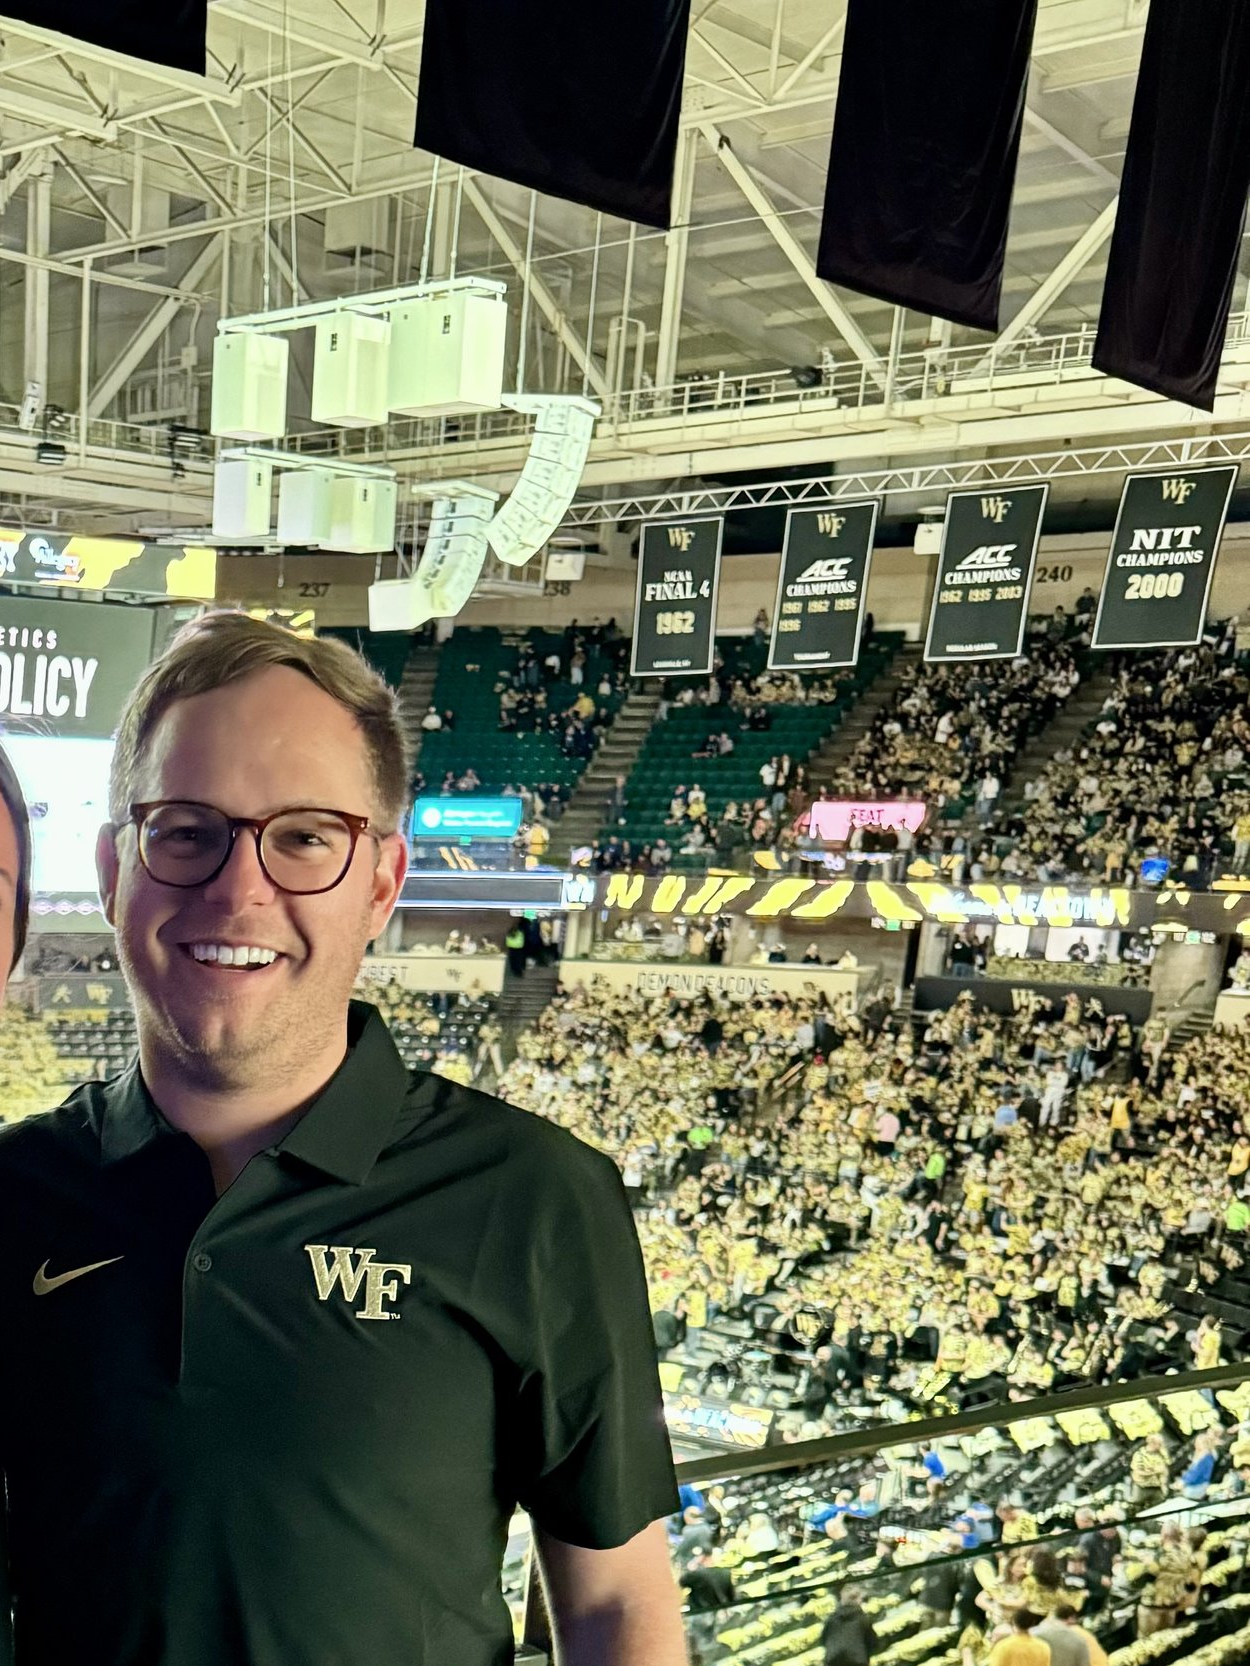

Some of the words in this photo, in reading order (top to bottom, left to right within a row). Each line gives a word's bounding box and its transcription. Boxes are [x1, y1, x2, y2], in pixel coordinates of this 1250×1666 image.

[1161, 479, 1197, 505] WF
[981, 496, 1013, 523] WF
[816, 512, 847, 538] WF
[667, 527, 696, 552] WF
[1129, 525, 1202, 551] NIT
[960, 544, 1018, 566] ACC
[1116, 550, 1205, 568] CHAMPIONS
[798, 557, 853, 580] ACC
[944, 568, 1021, 586] CHAMPIONS
[1036, 566, 1073, 583] 240
[299, 582, 331, 598] 237
[645, 581, 698, 601] FINAL
[699, 579, 710, 598] 4
[786, 580, 857, 597] CHAMPIONS
[1124, 572, 1185, 600] 2000
[656, 610, 695, 635] 1962
[304, 1244, 412, 1320] WF
